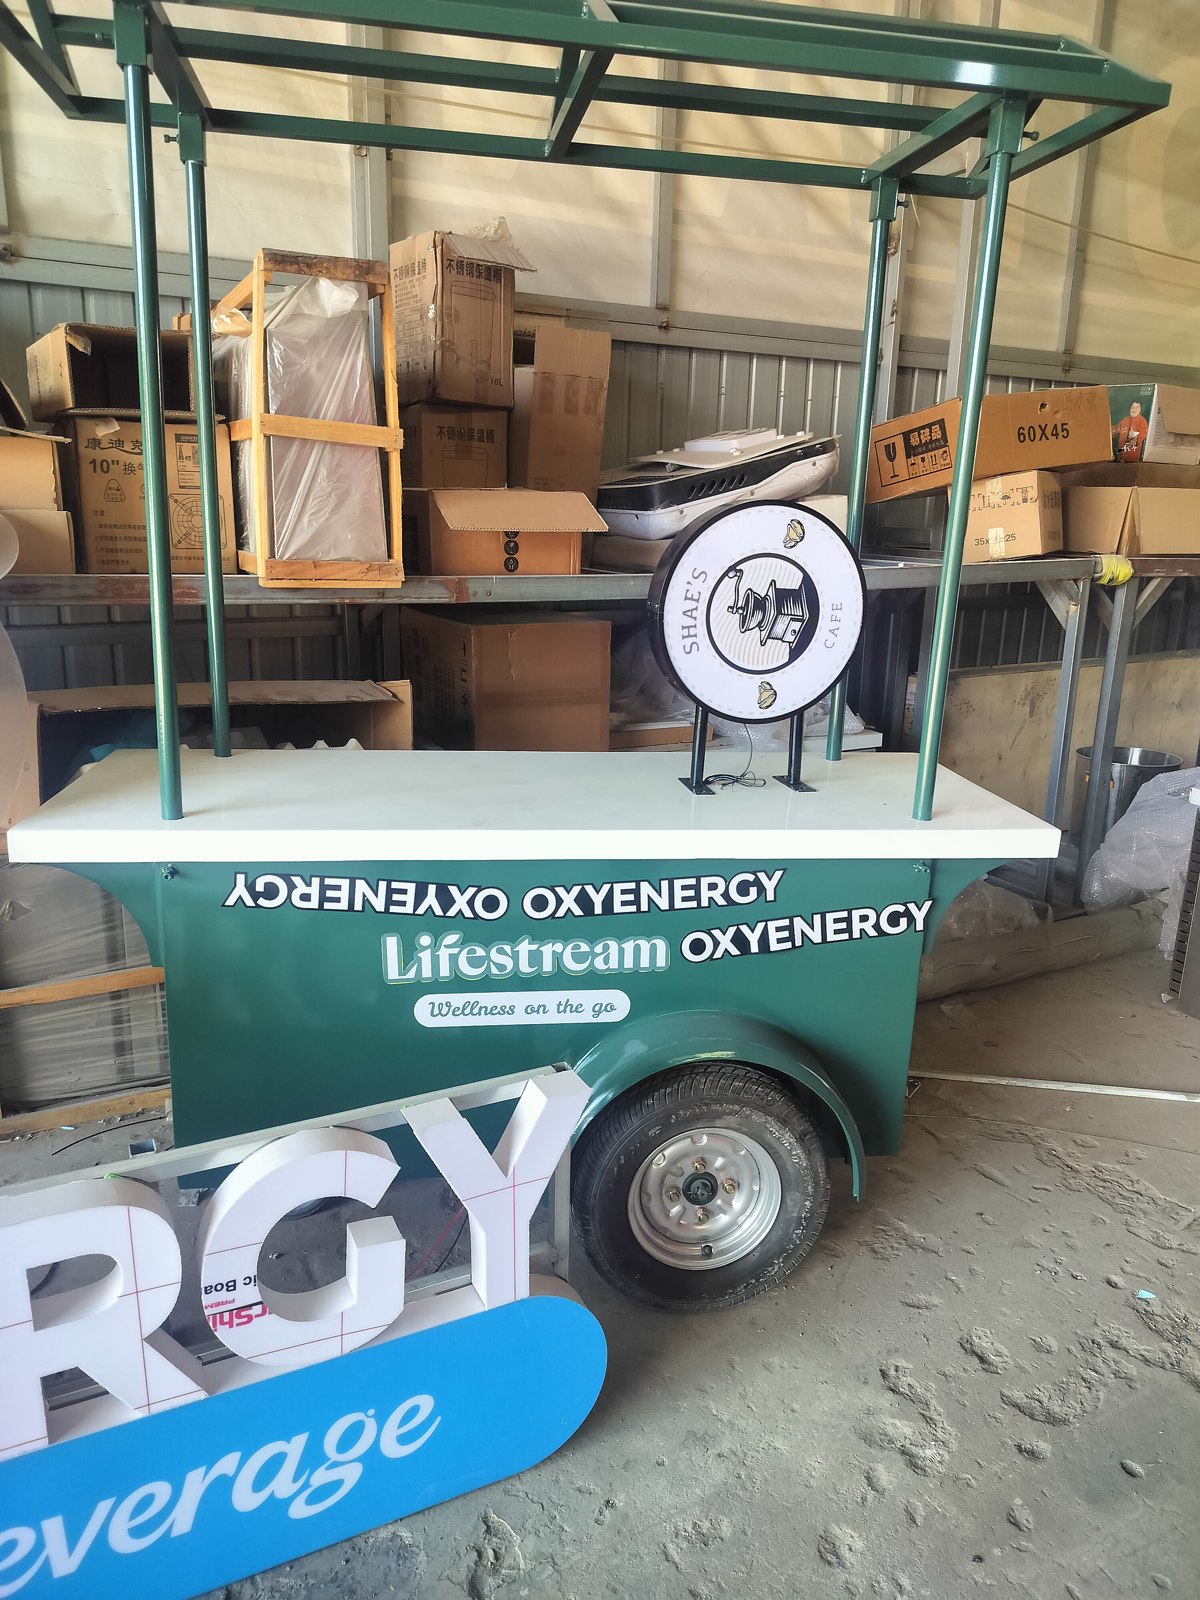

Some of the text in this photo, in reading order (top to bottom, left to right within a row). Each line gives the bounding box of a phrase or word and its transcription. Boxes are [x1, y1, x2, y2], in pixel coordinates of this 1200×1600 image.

[909, 424, 942, 447] 易碎品
[1017, 422, 1070, 444] 60X45
[681, 567, 707, 655] SHAE'S
[824, 602, 843, 649] CAFE
[222, 872, 509, 921] OXYENERGY
[523, 868, 787, 920] OXYENERGY
[681, 898, 934, 963] OXYENERGY
[383, 932, 670, 983] Lifestream
[428, 999, 617, 1019] Wellness on the go
